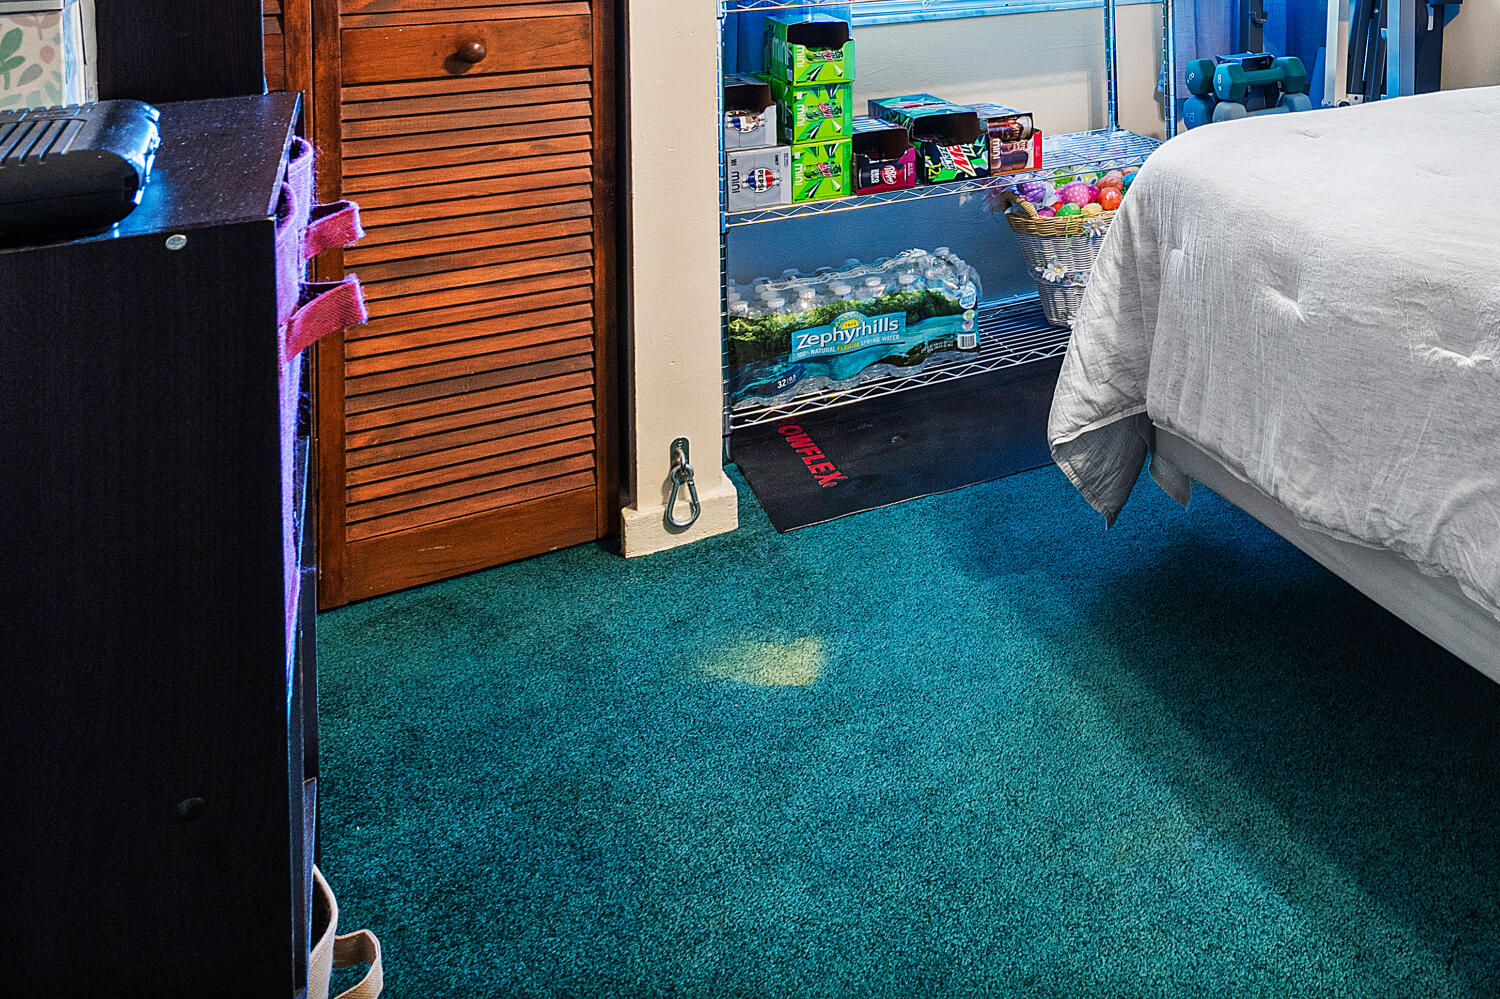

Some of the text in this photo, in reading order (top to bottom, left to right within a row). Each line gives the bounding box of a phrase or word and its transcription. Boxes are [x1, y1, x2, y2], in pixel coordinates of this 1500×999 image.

[796, 45, 805, 67] mini
[797, 104, 805, 126] mini
[992, 138, 1001, 160] mini
[731, 171, 740, 193] mini
[795, 163, 803, 186] mini
[797, 317, 899, 350] Zephyrhills
[810, 346, 836, 355] NATURAL
[860, 338, 880, 346] SPRING
[882, 334, 900, 342] WATER
[777, 379, 787, 388] 32
